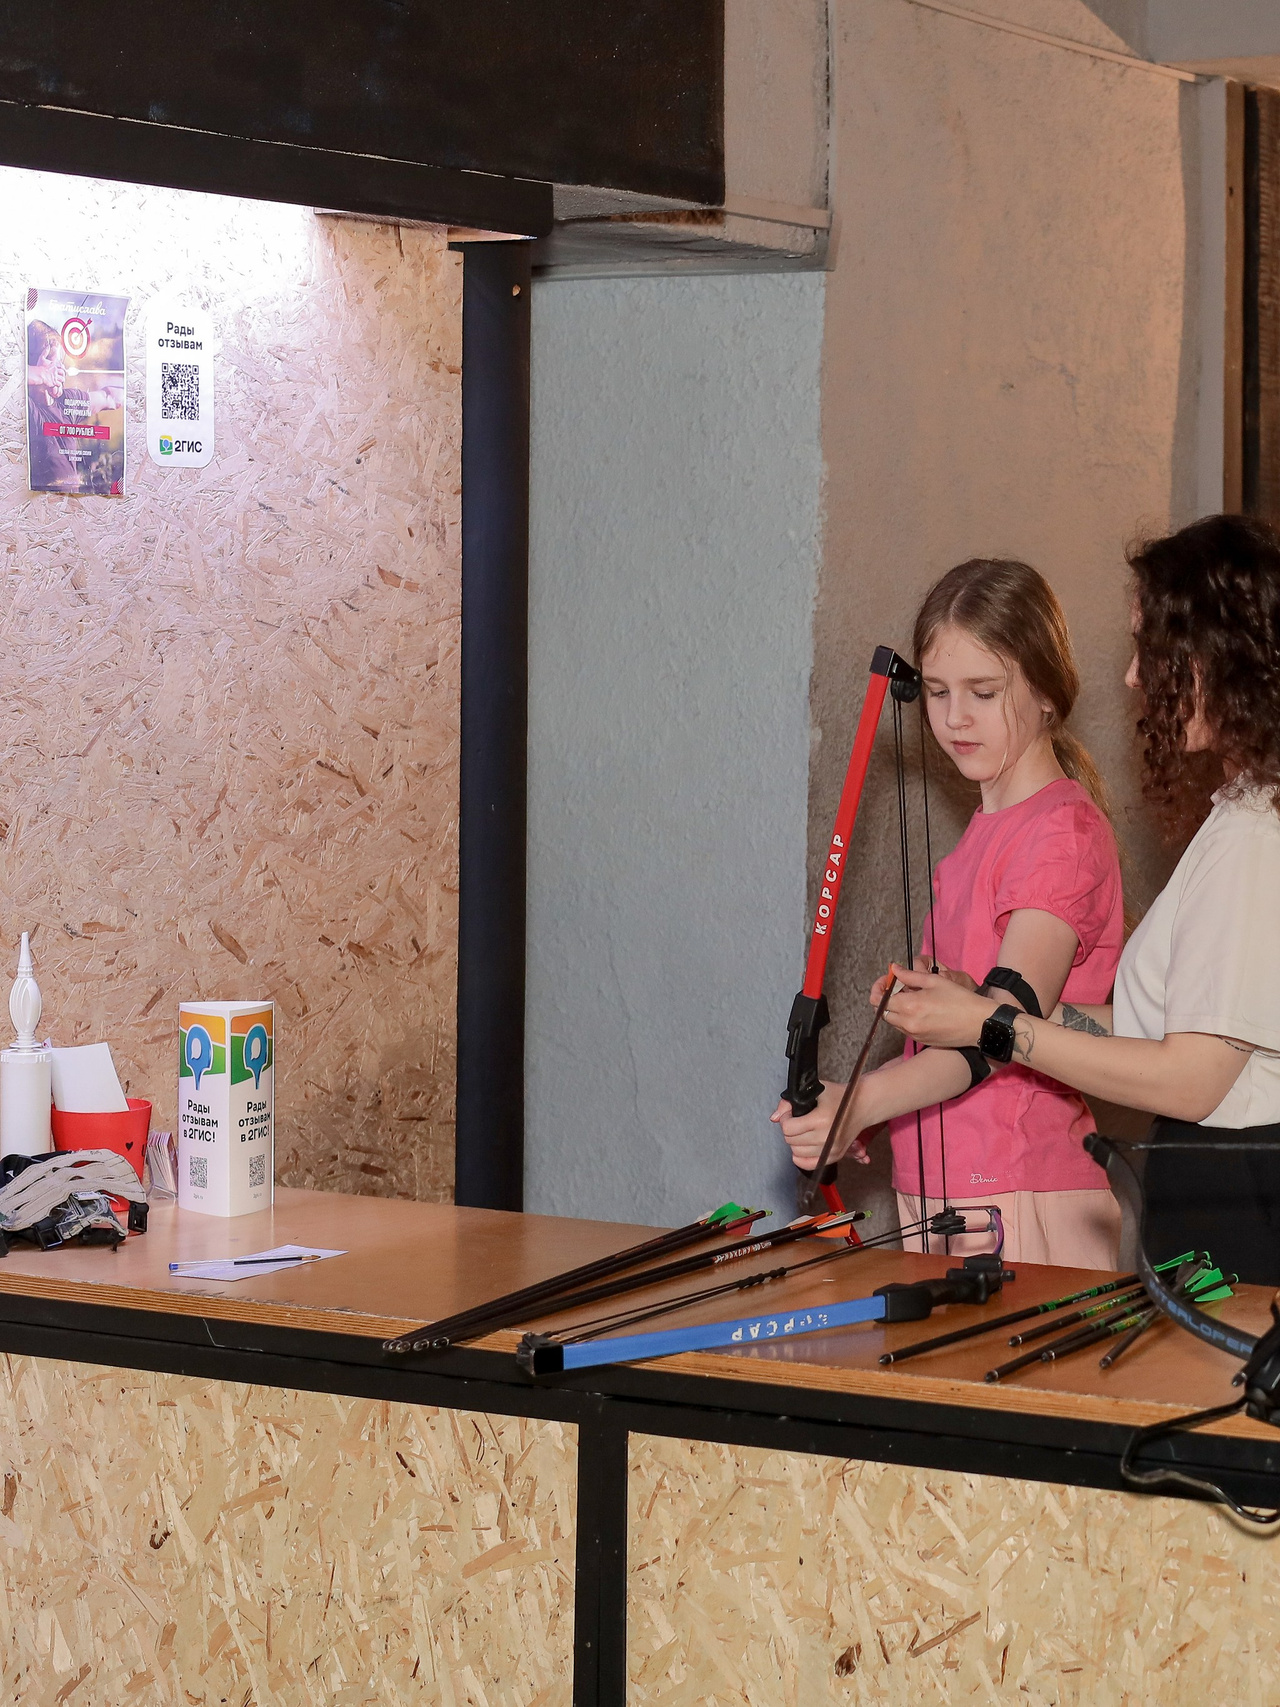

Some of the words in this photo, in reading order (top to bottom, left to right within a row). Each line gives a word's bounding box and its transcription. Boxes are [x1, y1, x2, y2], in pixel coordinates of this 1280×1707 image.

[166, 321, 195, 337] Рады
[158, 338, 203, 350] отзывам
[174, 440, 203, 453] 2ГИС
[814, 833, 845, 936] КОРСАР
[187, 1099, 210, 1115] Рады
[246, 1100, 267, 1114] Рады
[181, 1114, 219, 1128] отзывам
[238, 1112, 271, 1127] отзывам
[183, 1129, 189, 1138] в
[188, 1127, 216, 1143] 2ГИС!
[240, 1133, 247, 1143] в
[247, 1124, 270, 1141] 2ГИС!
